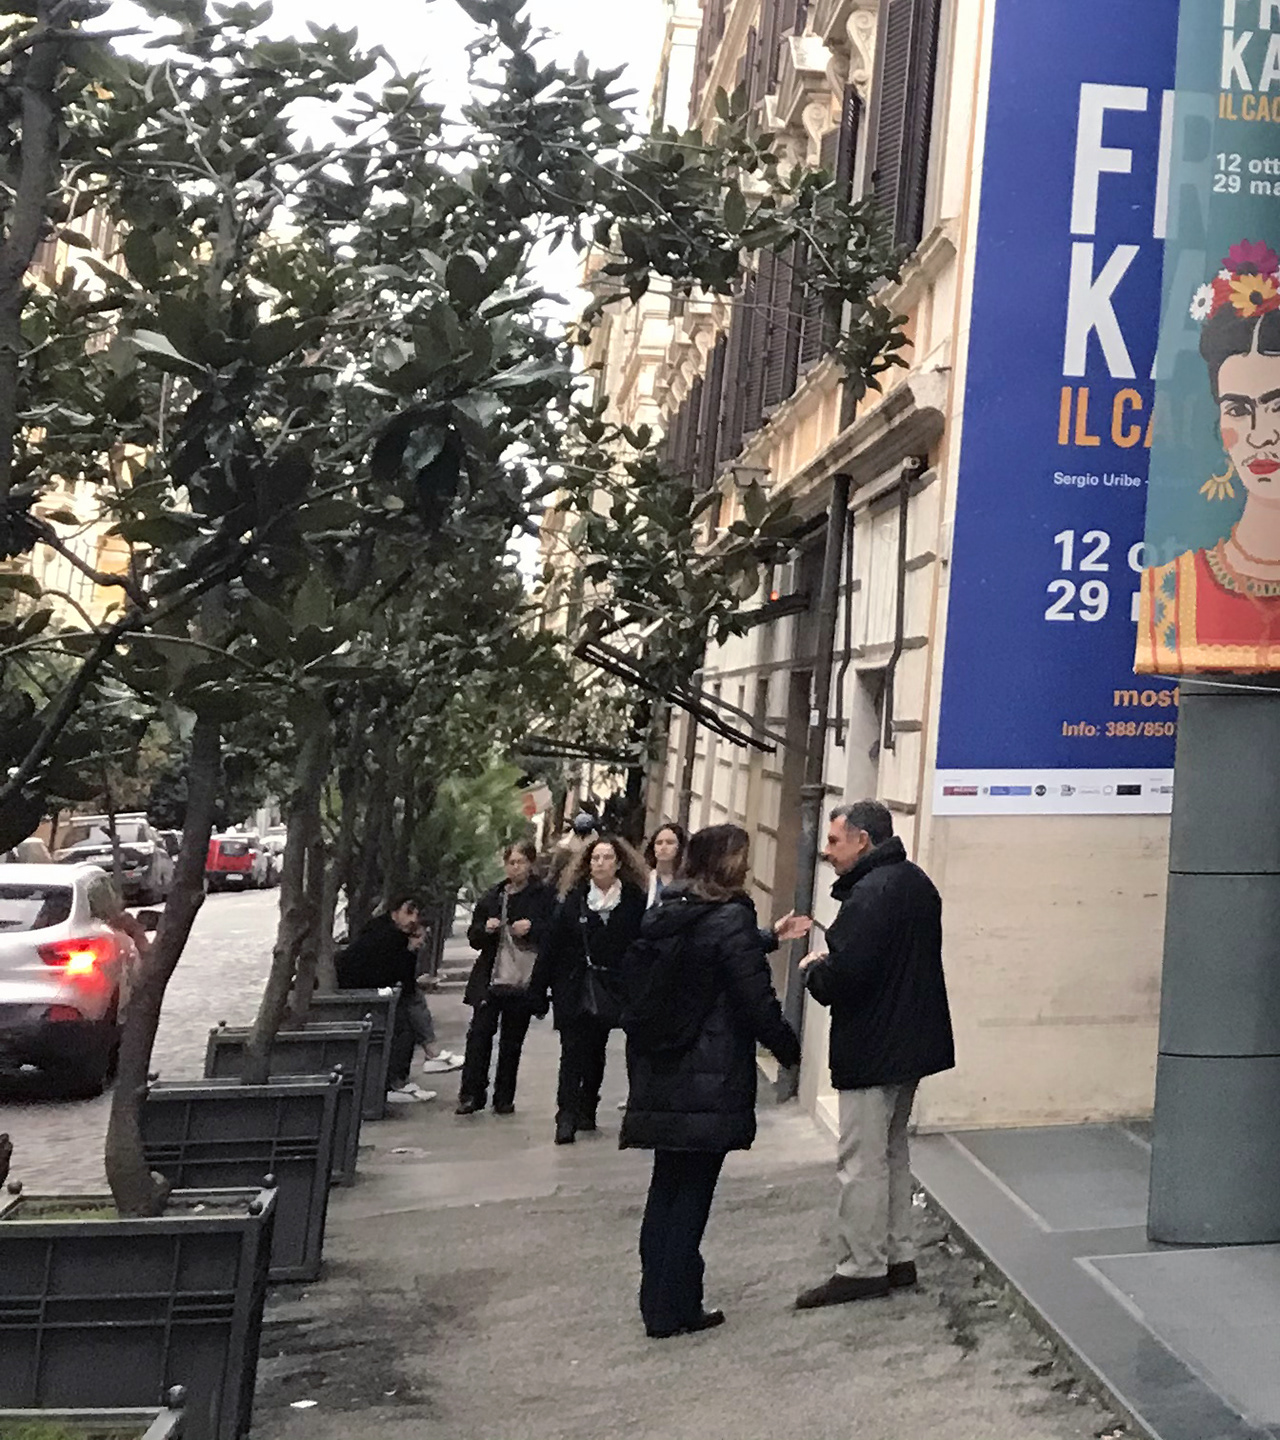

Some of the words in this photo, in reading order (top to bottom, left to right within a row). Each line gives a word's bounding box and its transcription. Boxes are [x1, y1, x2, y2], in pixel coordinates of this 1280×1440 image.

[1218, 92, 1238, 121] IL
[1216, 153, 1242, 173] 12
[1212, 173, 1242, 194] 29
[1057, 386, 1101, 446] IL
[1053, 471, 1099, 488] Sergio
[1103, 473, 1142, 488] Uribe
[1053, 529, 1112, 572] 12
[1044, 579, 1110, 622] 29
[1062, 720, 1101, 737] Info:
[1104, 720, 1177, 737] 388/850
